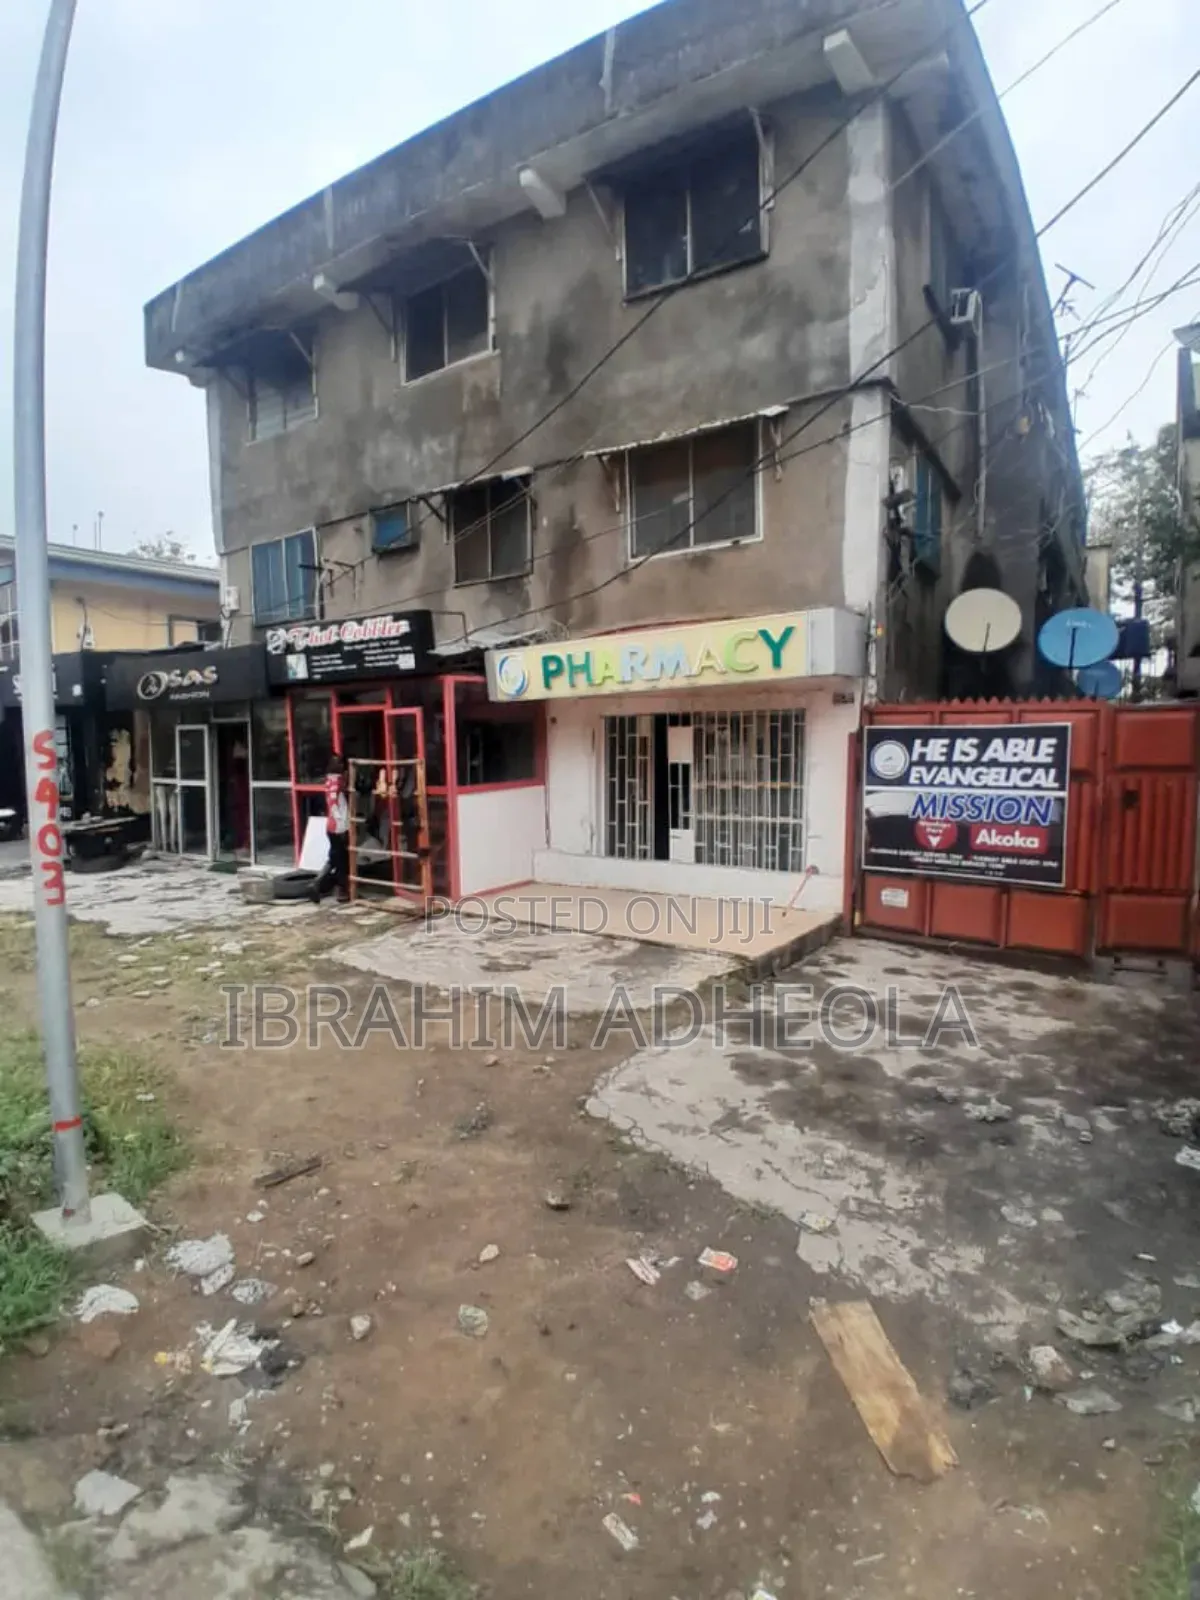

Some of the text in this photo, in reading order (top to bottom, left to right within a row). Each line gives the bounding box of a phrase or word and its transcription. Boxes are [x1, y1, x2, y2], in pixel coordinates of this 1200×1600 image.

[541, 626, 795, 689] PHARMACY
[910, 738, 1058, 763] HE IS ABLE
[908, 766, 1060, 788] EVANGELICAL
[910, 793, 1054, 826] MISSION
[976, 828, 1041, 848] Akoka
